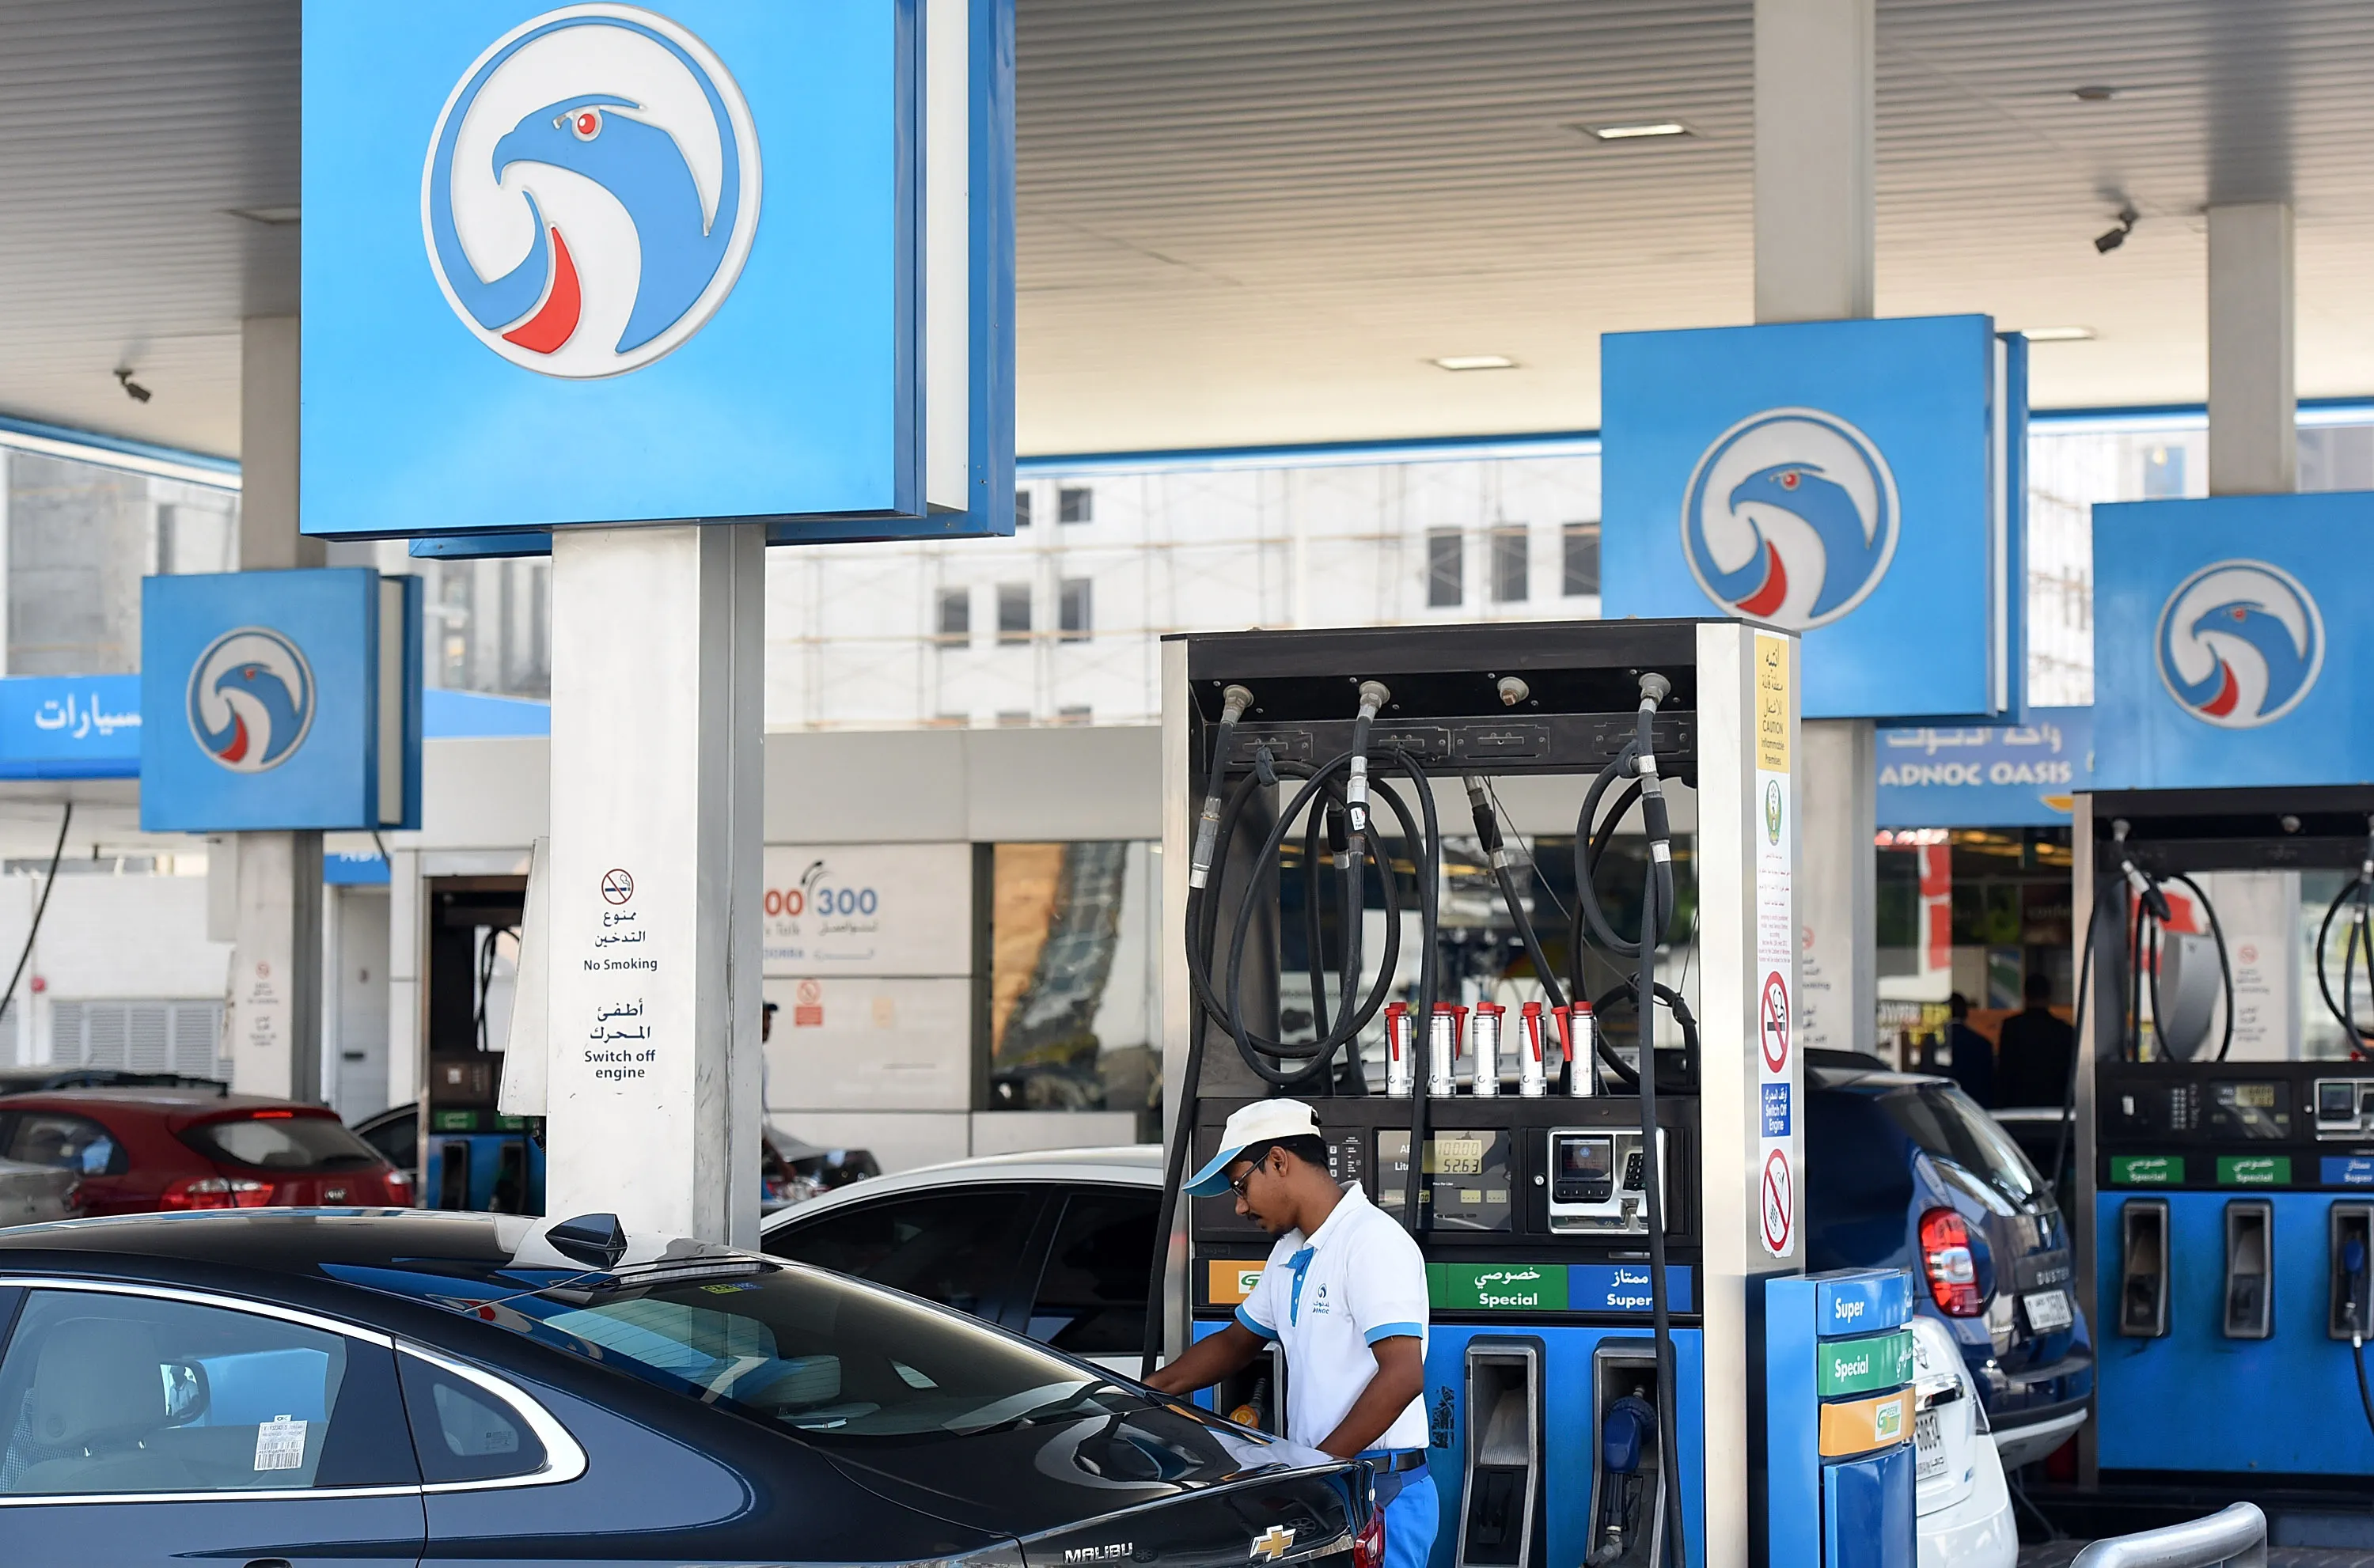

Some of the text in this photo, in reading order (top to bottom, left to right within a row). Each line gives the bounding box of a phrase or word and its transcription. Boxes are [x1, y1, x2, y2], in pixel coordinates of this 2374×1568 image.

[1762, 720, 1784, 735] CAUTION
[1761, 737, 1784, 751] Inflammable
[1765, 754, 1782, 766] Premises
[1879, 761, 2073, 786] ADNOC OASIS
[764, 888, 877, 916] 00 300
[603, 910, 636, 927] ممنوع
[595, 930, 646, 948] التدخين
[584, 957, 658, 971] No Smoking
[597, 998, 643, 1022] أطفئ
[590, 1025, 650, 1043] المحرك
[585, 1049, 656, 1062] Switch off
[596, 1066, 645, 1081] engine
[1765, 1104, 1780, 1116] Switch
[1769, 1118, 1784, 1134] Engine
[1438, 1142, 1479, 1156] 100.00
[1444, 1159, 1479, 1172] 52.63
[2236, 1172, 2274, 1184] Special
[1474, 1267, 1648, 1290] خصوصي ممتاز
[1479, 1293, 1653, 1309] Special Super
[1836, 1297, 1864, 1323] Super
[1834, 1354, 1869, 1383] Special
[1064, 1542, 1133, 1564] MALIBU
